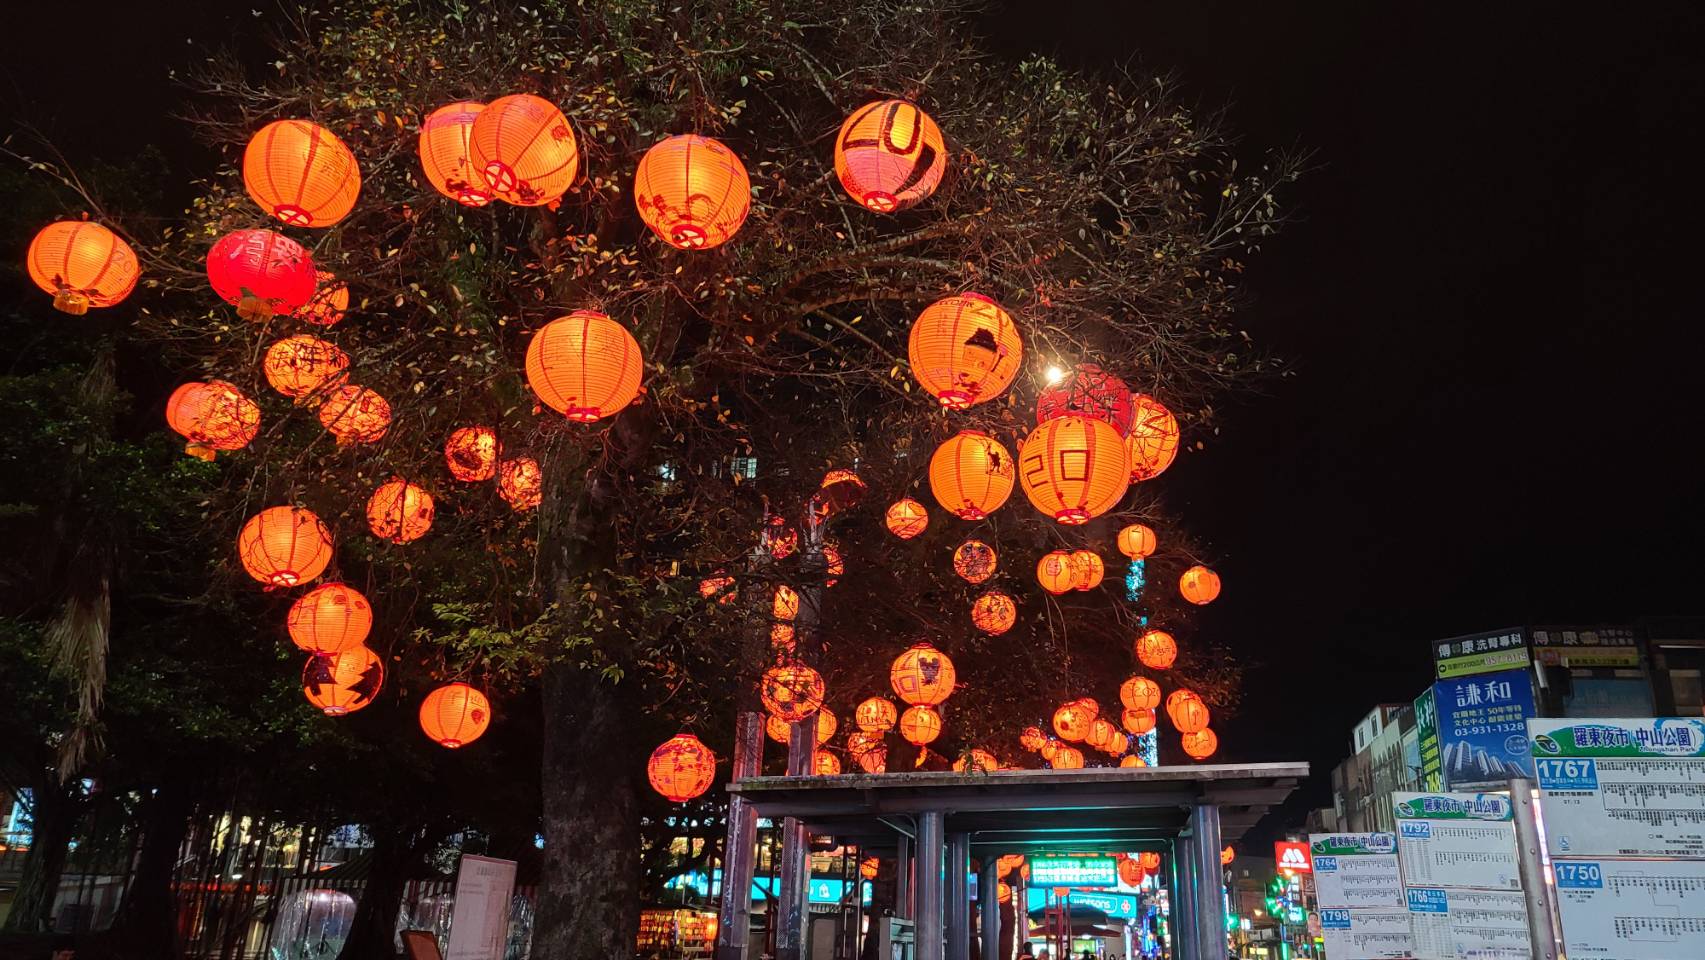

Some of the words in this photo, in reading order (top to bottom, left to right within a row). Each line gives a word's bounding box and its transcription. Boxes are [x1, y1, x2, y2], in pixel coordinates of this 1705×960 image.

[1454, 722, 1525, 737] 03-931-1328
[1538, 760, 1590, 778] 1767
[1401, 823, 1429, 833] 1792
[1315, 858, 1336, 867] 1764
[1556, 866, 1600, 880] 1750
[1321, 910, 1349, 921] 1798
